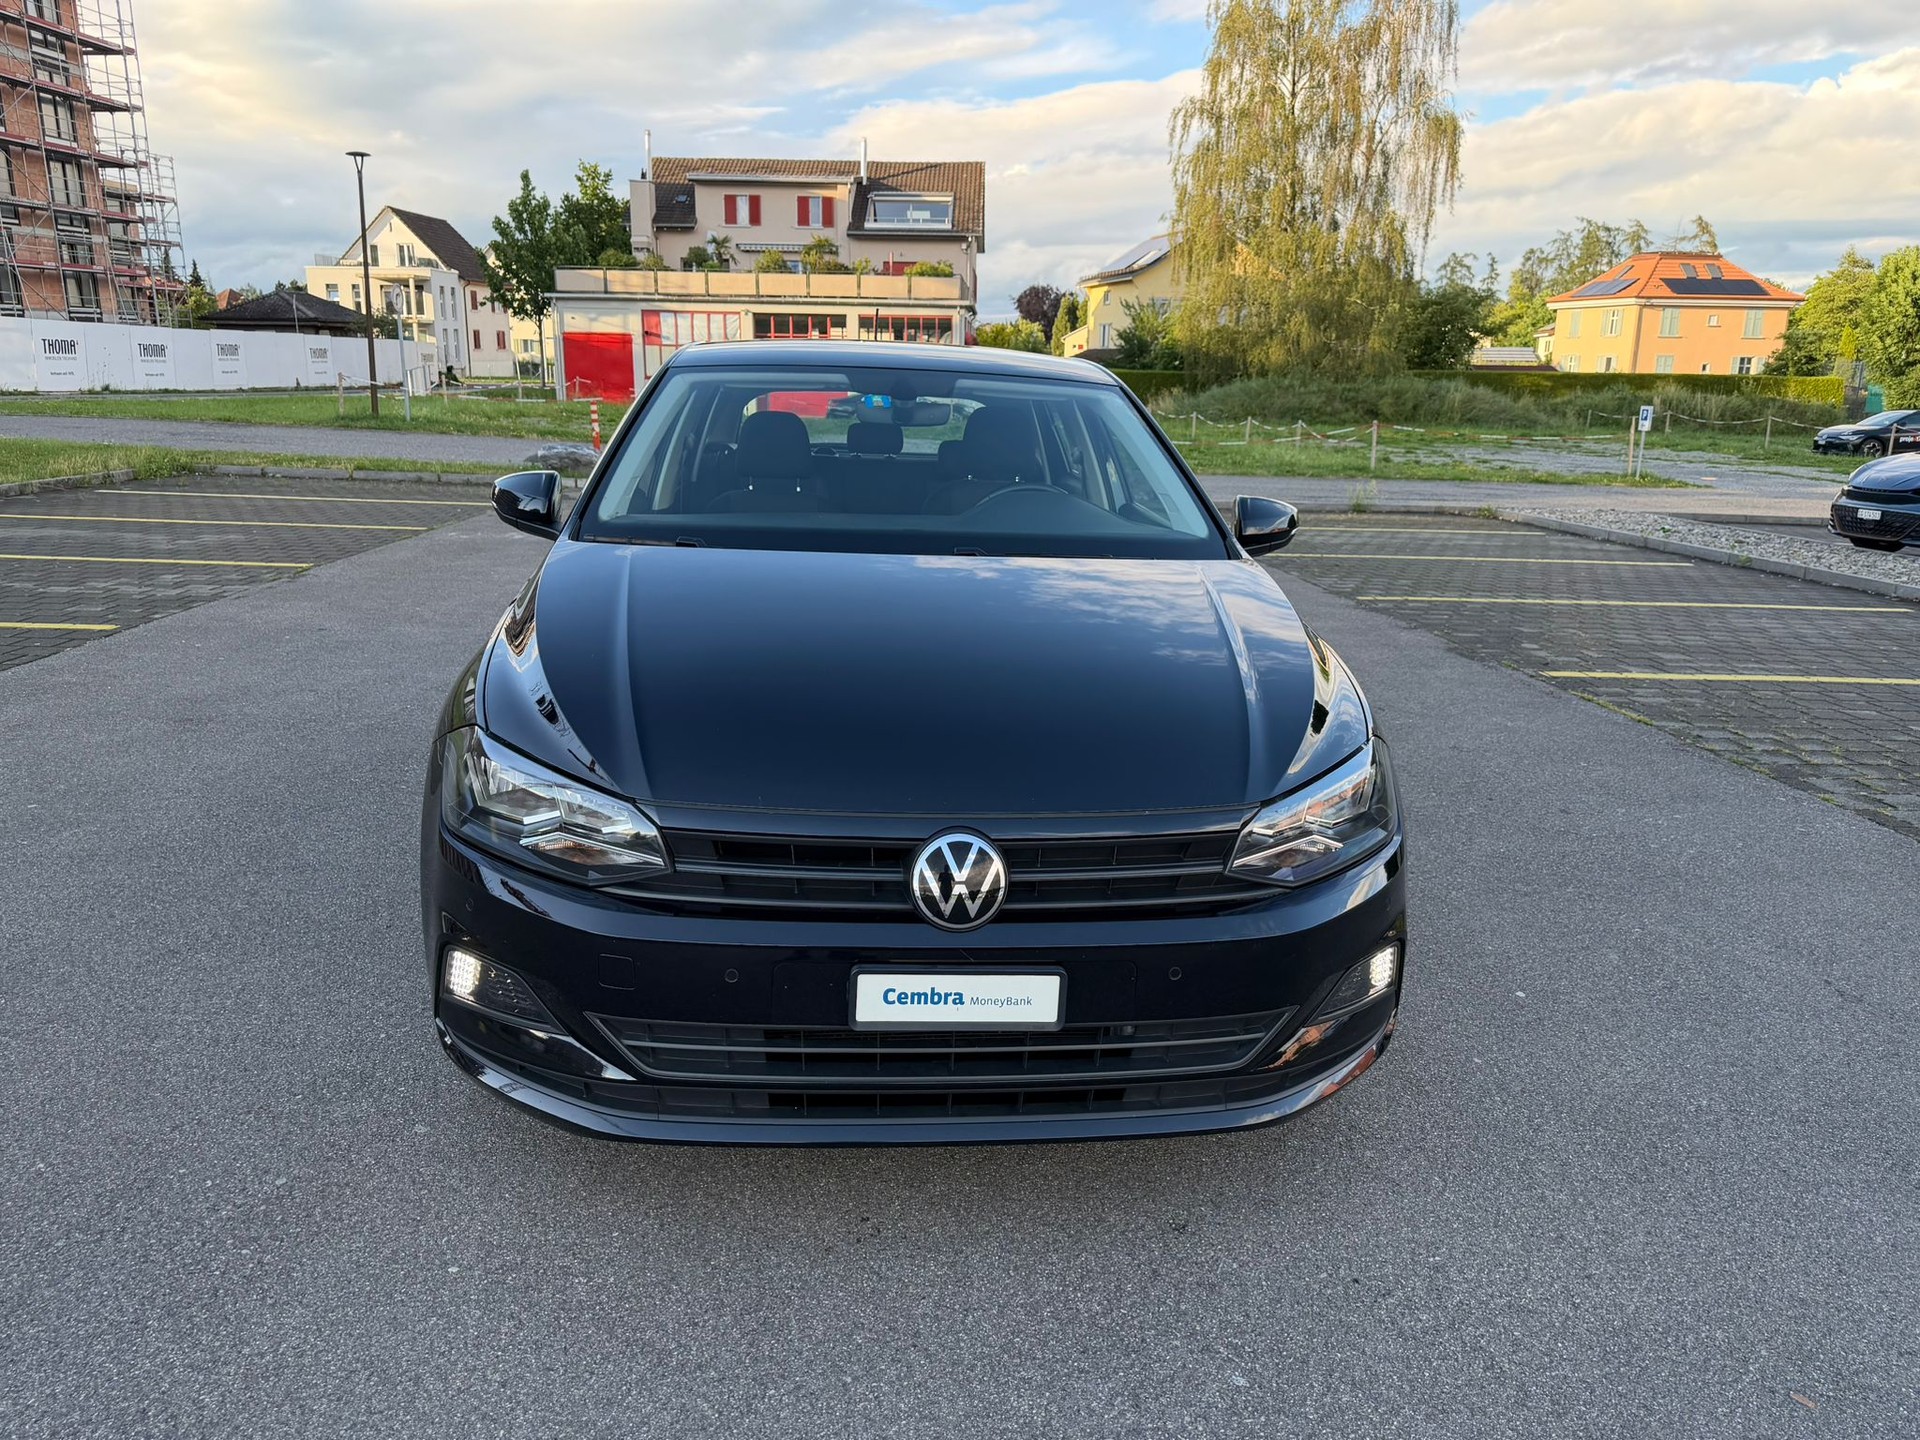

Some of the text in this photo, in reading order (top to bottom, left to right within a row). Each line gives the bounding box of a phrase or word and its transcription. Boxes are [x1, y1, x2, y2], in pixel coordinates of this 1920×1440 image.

[41, 338, 77, 355] THOMA
[137, 343, 166, 358] THOMA
[882, 987, 1033, 1008] Cembra MoneyBank
